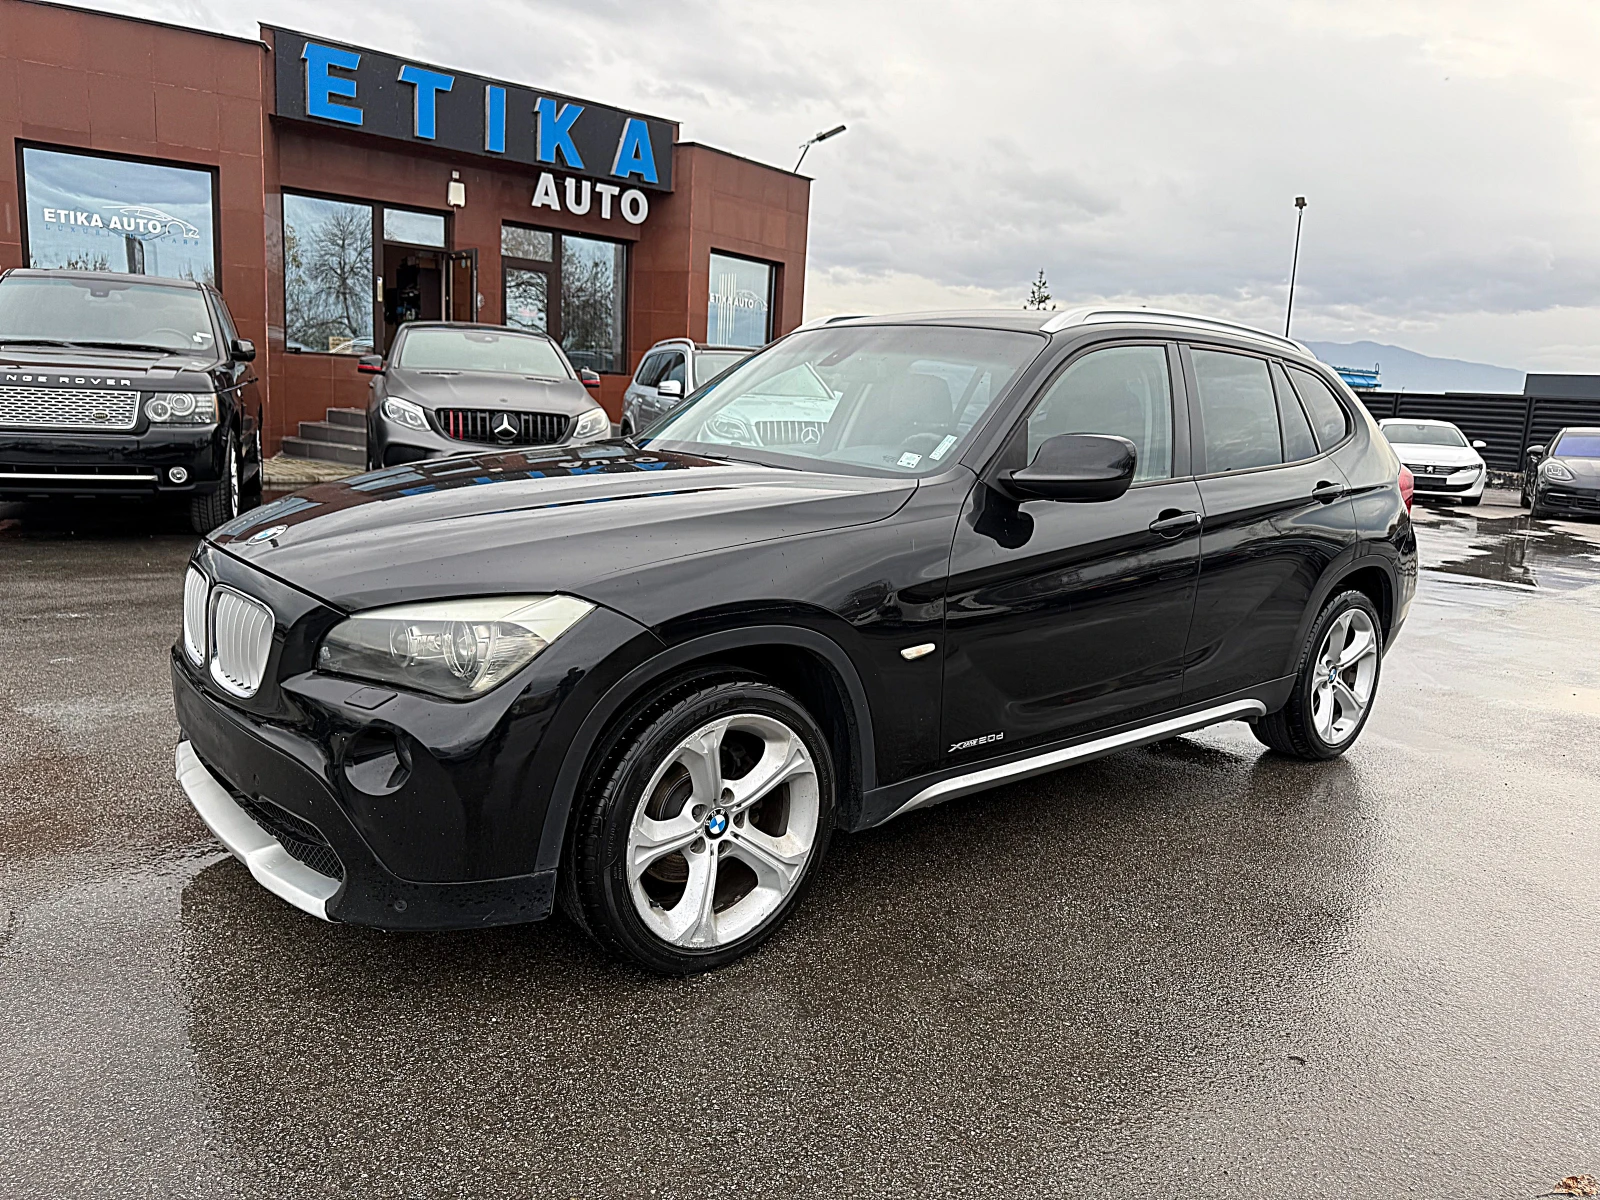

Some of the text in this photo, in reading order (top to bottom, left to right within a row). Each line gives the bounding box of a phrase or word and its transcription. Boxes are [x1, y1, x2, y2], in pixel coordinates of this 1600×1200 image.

[300, 41, 660, 184] ETIKA
[531, 171, 649, 225] AUTO
[43, 208, 162, 234] ETIKA AUTO
[733, 296, 754, 309] AUTO
[6, 374, 131, 387] NGE ROVER
